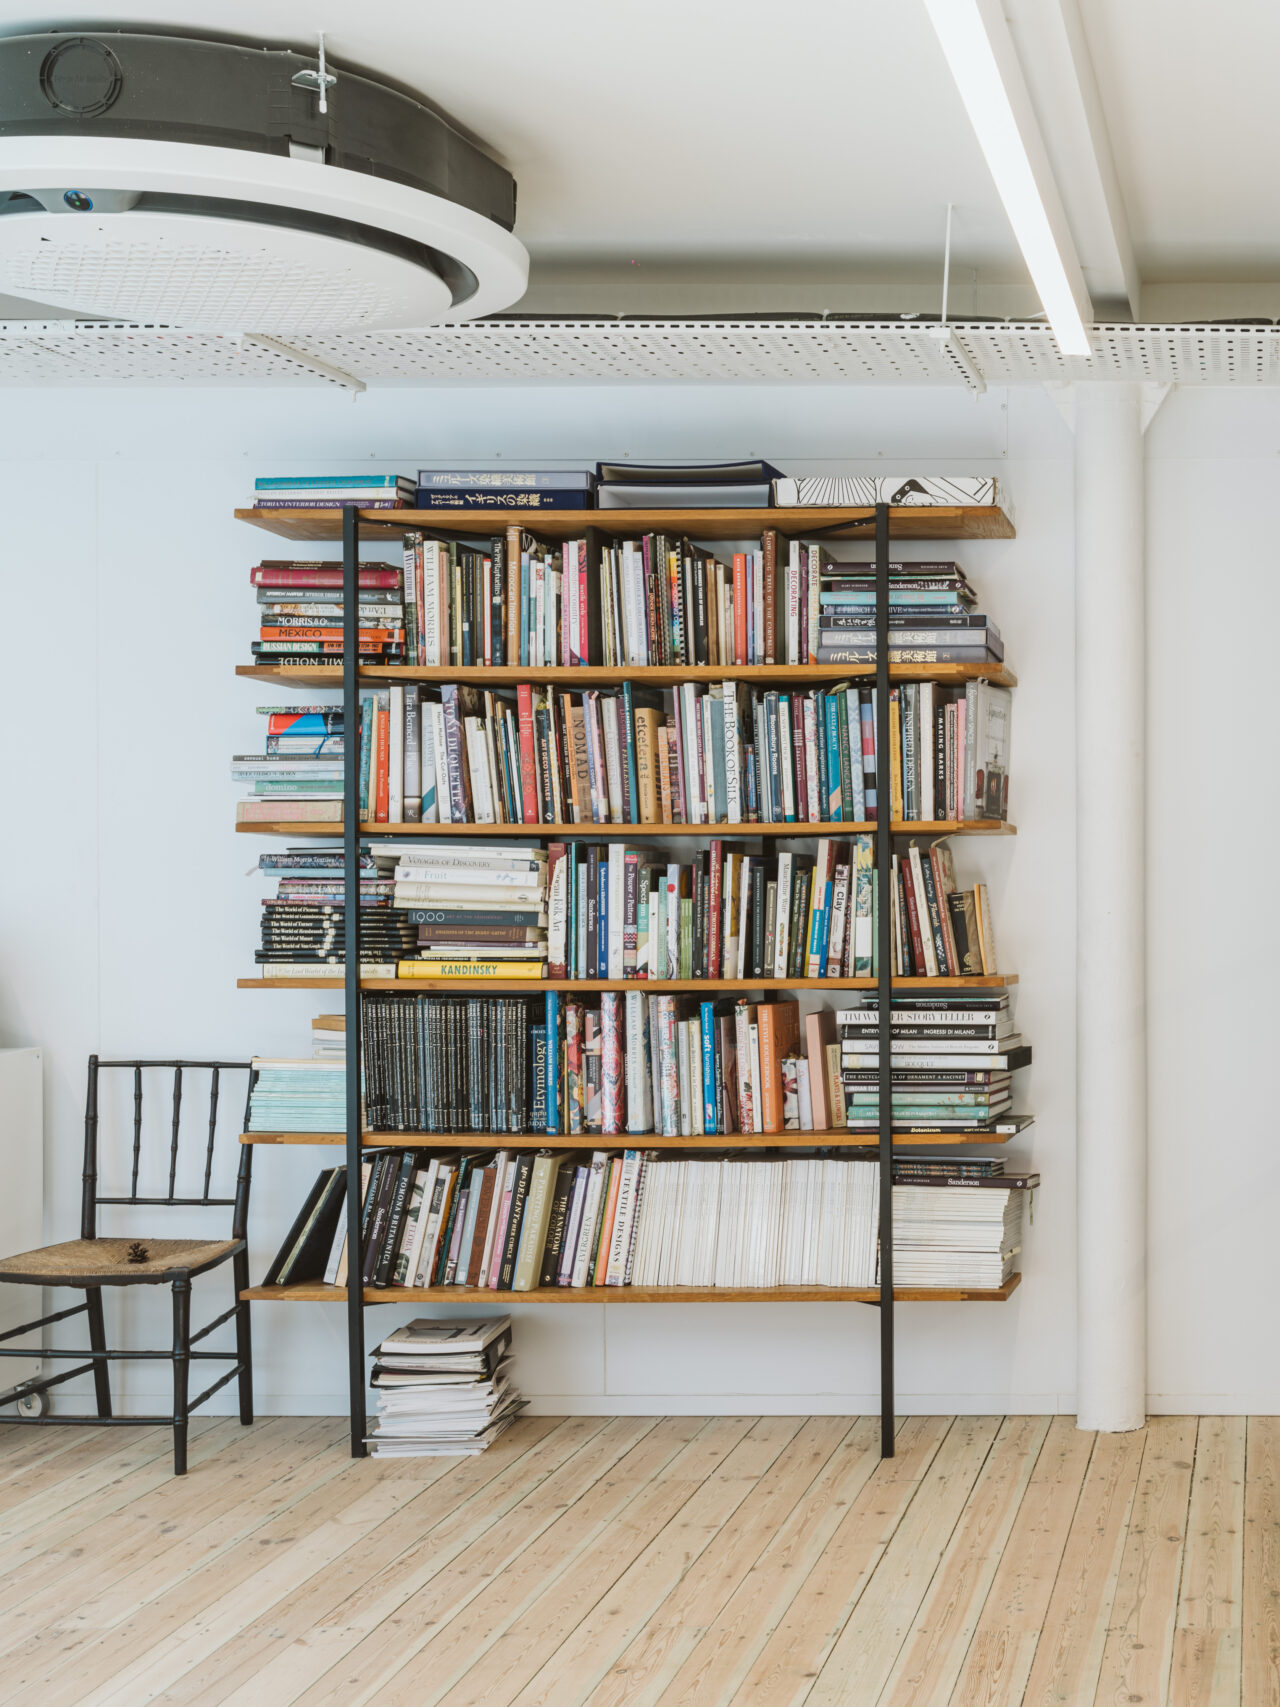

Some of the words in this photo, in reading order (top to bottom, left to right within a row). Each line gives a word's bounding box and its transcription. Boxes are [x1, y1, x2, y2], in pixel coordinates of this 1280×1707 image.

[426, 545, 435, 597] WILLIAM
[508, 560, 517, 601] Moroccan
[278, 617, 312, 626] MORRIS
[427, 602, 436, 647] MORRIS
[508, 602, 517, 636] Interiors
[843, 605, 871, 614] FRENCH
[279, 629, 322, 638] MEXICO
[322, 657, 344, 666] MIL
[406, 692, 417, 711] Tara
[724, 691, 735, 719] THE
[406, 711, 417, 745] Bernerd
[444, 700, 457, 735] TONY
[769, 714, 777, 752] Bloomsbury
[904, 711, 914, 754] INSPIRED
[573, 719, 588, 779] NOMAD
[724, 721, 736, 758] BOOK
[447, 737, 462, 805] DUQUETTE
[726, 759, 736, 775] OF
[844, 757, 853, 801] LANCASTER
[906, 757, 915, 791] DESIGN
[543, 770, 551, 801] TEXTILES
[727, 777, 738, 805] SILK
[408, 855, 440, 865] VOYAGES
[451, 859, 491, 868] DISCOVERY
[423, 870, 448, 879] Fruit
[781, 863, 790, 896] Mauchline
[553, 898, 563, 917] Folk
[639, 879, 649, 917] Spectrum
[834, 891, 844, 912] Clay
[412, 911, 445, 924] 1900
[553, 917, 563, 932] Art
[928, 902, 939, 927] Flourish
[441, 965, 498, 975] KANDINSKY
[630, 994, 639, 1031] WILLIAM
[906, 1014, 936, 1022] STORY
[939, 1014, 974, 1022] TELLER
[631, 1033, 640, 1064] MORRIS
[704, 1035, 712, 1052] soft
[533, 1038, 546, 1109] Etymology
[833, 1075, 841, 1094] PLANTS
[394, 1177, 409, 1212] POMONA
[619, 1178, 631, 1217] TEXTILE
[947, 1178, 980, 1186] Sanderson
[558, 1196, 567, 1213] THE
[371, 1207, 385, 1240] Sanderson
[404, 1225, 417, 1252] FLORA
[551, 1216, 563, 1256] ANATOMY
[382, 1214, 399, 1265] BRITANNICA
[506, 1237, 515, 1259] CIRCLE
[578, 1216, 593, 1263] EVERGREEN
[613, 1221, 625, 1263] DESIGNS
